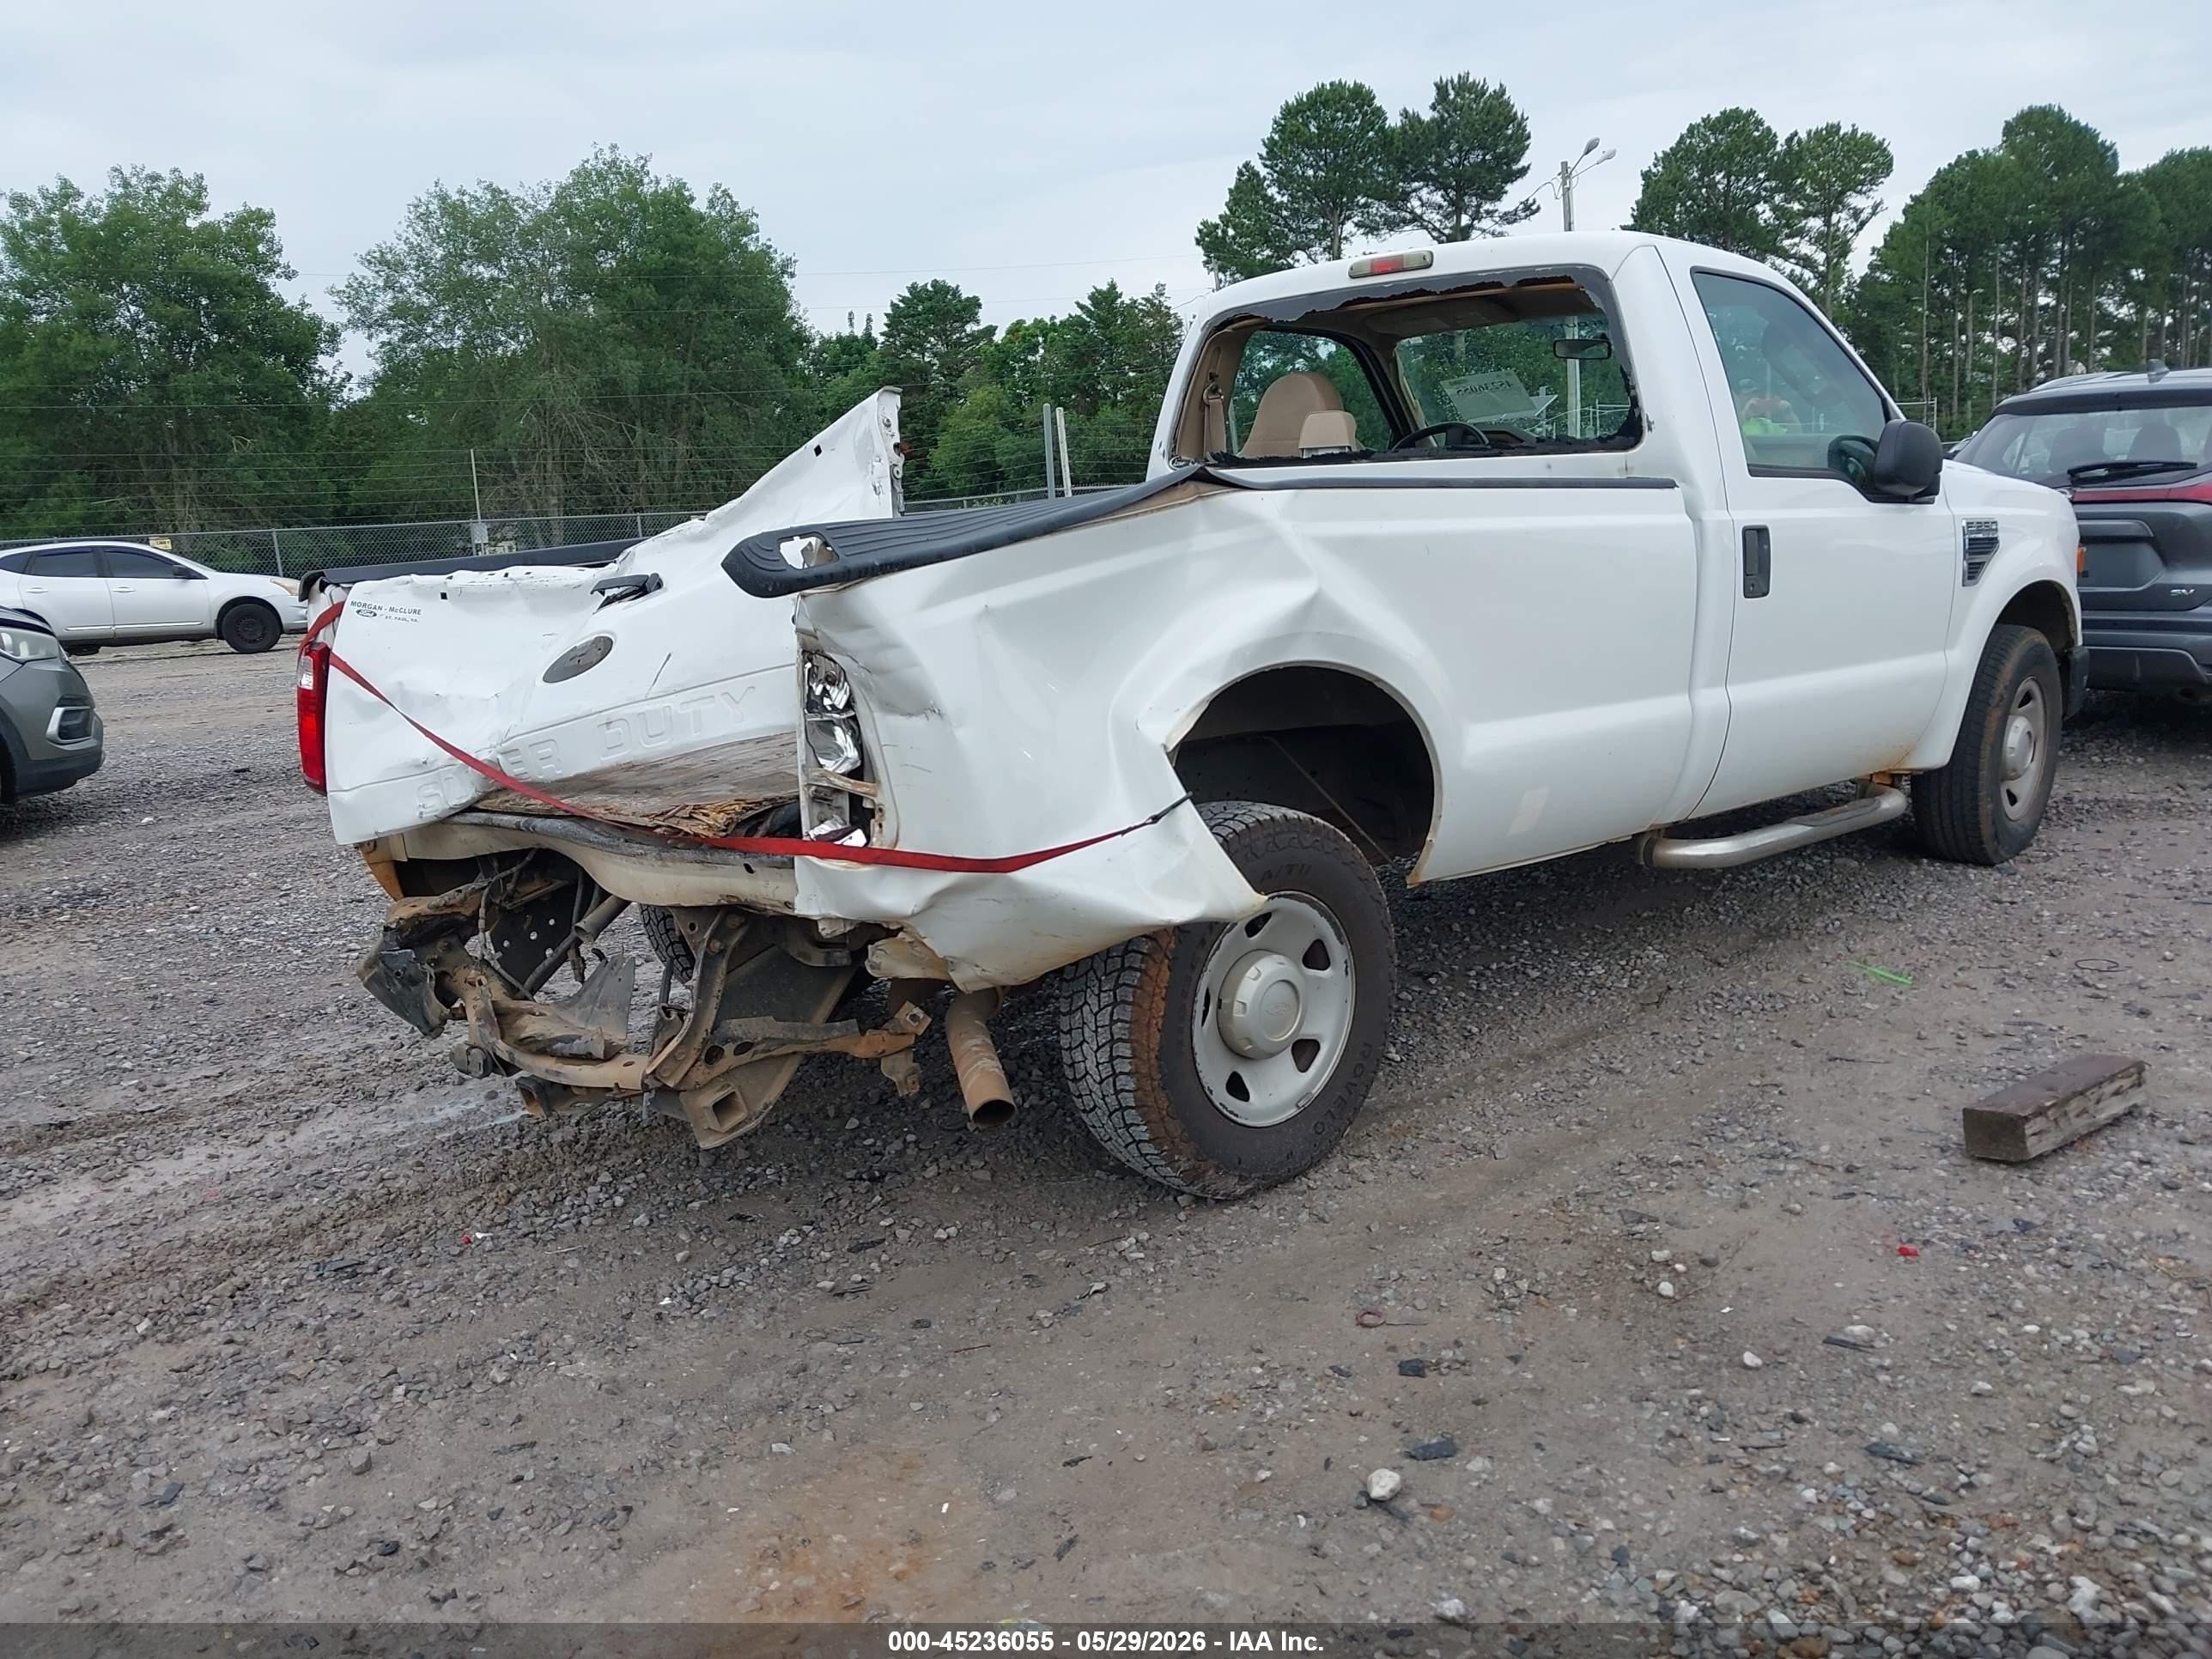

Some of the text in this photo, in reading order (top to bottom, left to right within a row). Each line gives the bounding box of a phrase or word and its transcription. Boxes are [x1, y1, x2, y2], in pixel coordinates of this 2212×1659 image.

[350, 600, 384, 611] MORGAN
[388, 606, 422, 616] McCLURE
[597, 685, 757, 763] DUTY
[1313, 1042, 1373, 1135] ROVELO
